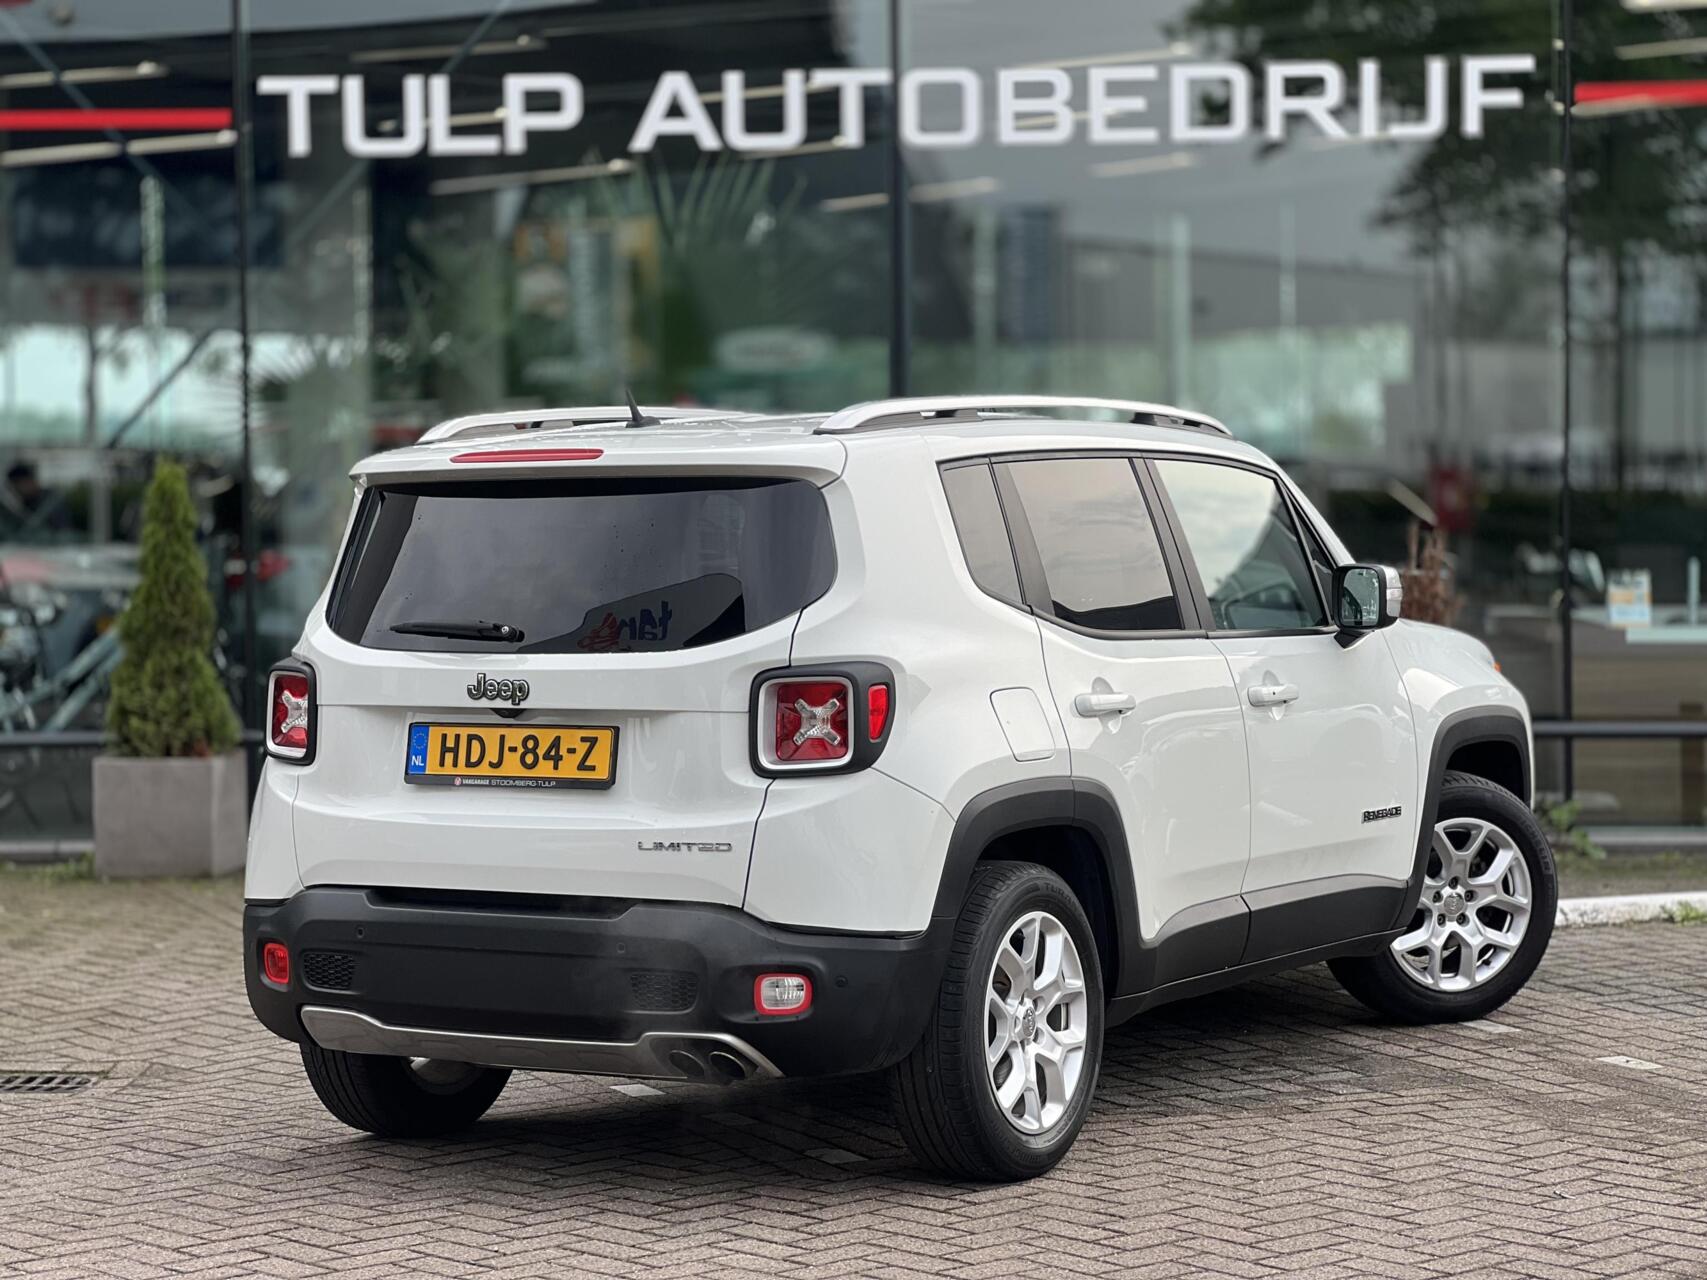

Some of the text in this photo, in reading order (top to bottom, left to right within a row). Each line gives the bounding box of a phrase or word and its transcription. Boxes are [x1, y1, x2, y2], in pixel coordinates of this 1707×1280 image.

[257, 55, 1536, 157] TULP AUTOBEDRIJF
[467, 672, 530, 705] Jeep
[411, 755, 425, 767] NL
[438, 733, 599, 772] HDJ-84-Z
[1362, 806, 1402, 823] RENEGADE
[637, 841, 733, 853] LIMITED
